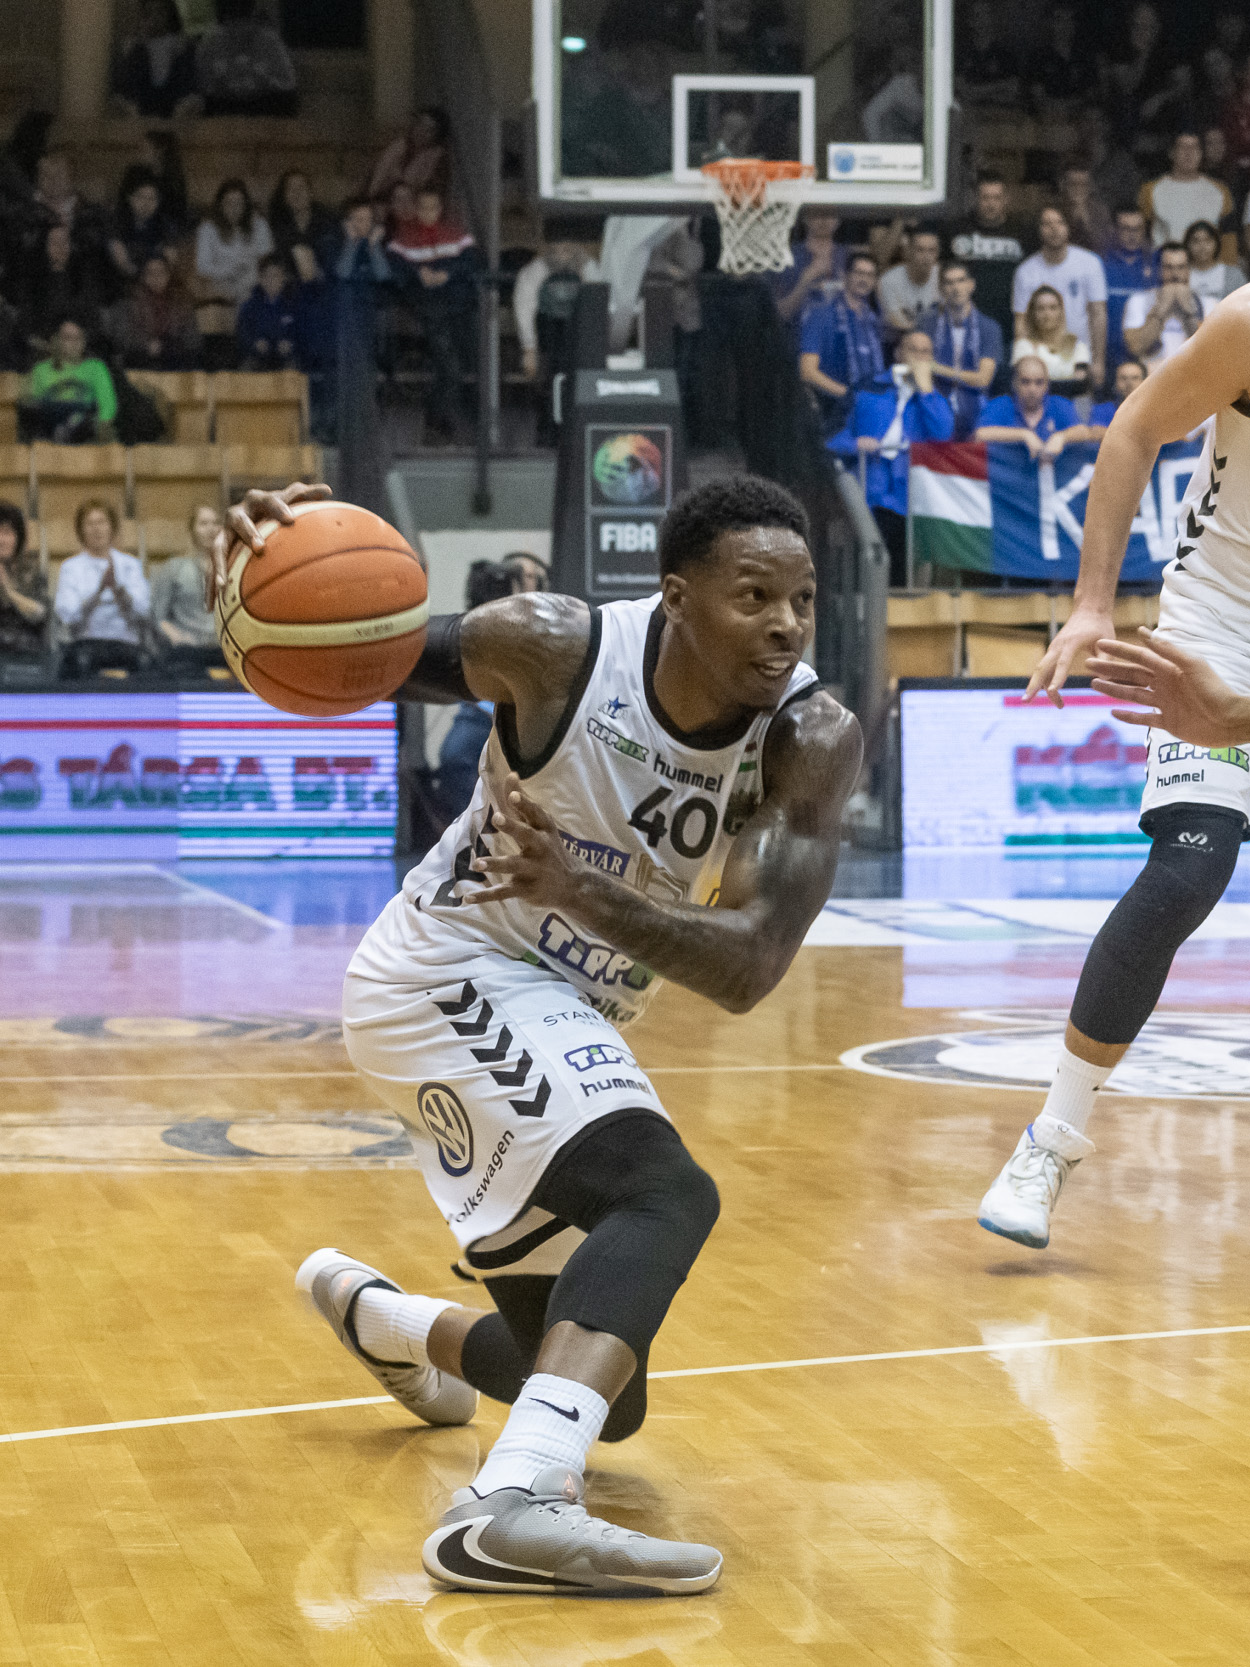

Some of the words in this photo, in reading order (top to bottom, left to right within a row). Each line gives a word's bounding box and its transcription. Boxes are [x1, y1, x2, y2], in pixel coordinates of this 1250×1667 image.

[601, 522, 657, 552] FIBA
[653, 753, 724, 793] hummel
[1156, 769, 1205, 788] hummel
[627, 785, 718, 859] 40
[563, 840, 623, 874] ÉRVÁR
[543, 1011, 607, 1026] STAN
[447, 1129, 515, 1224] olkswagen
